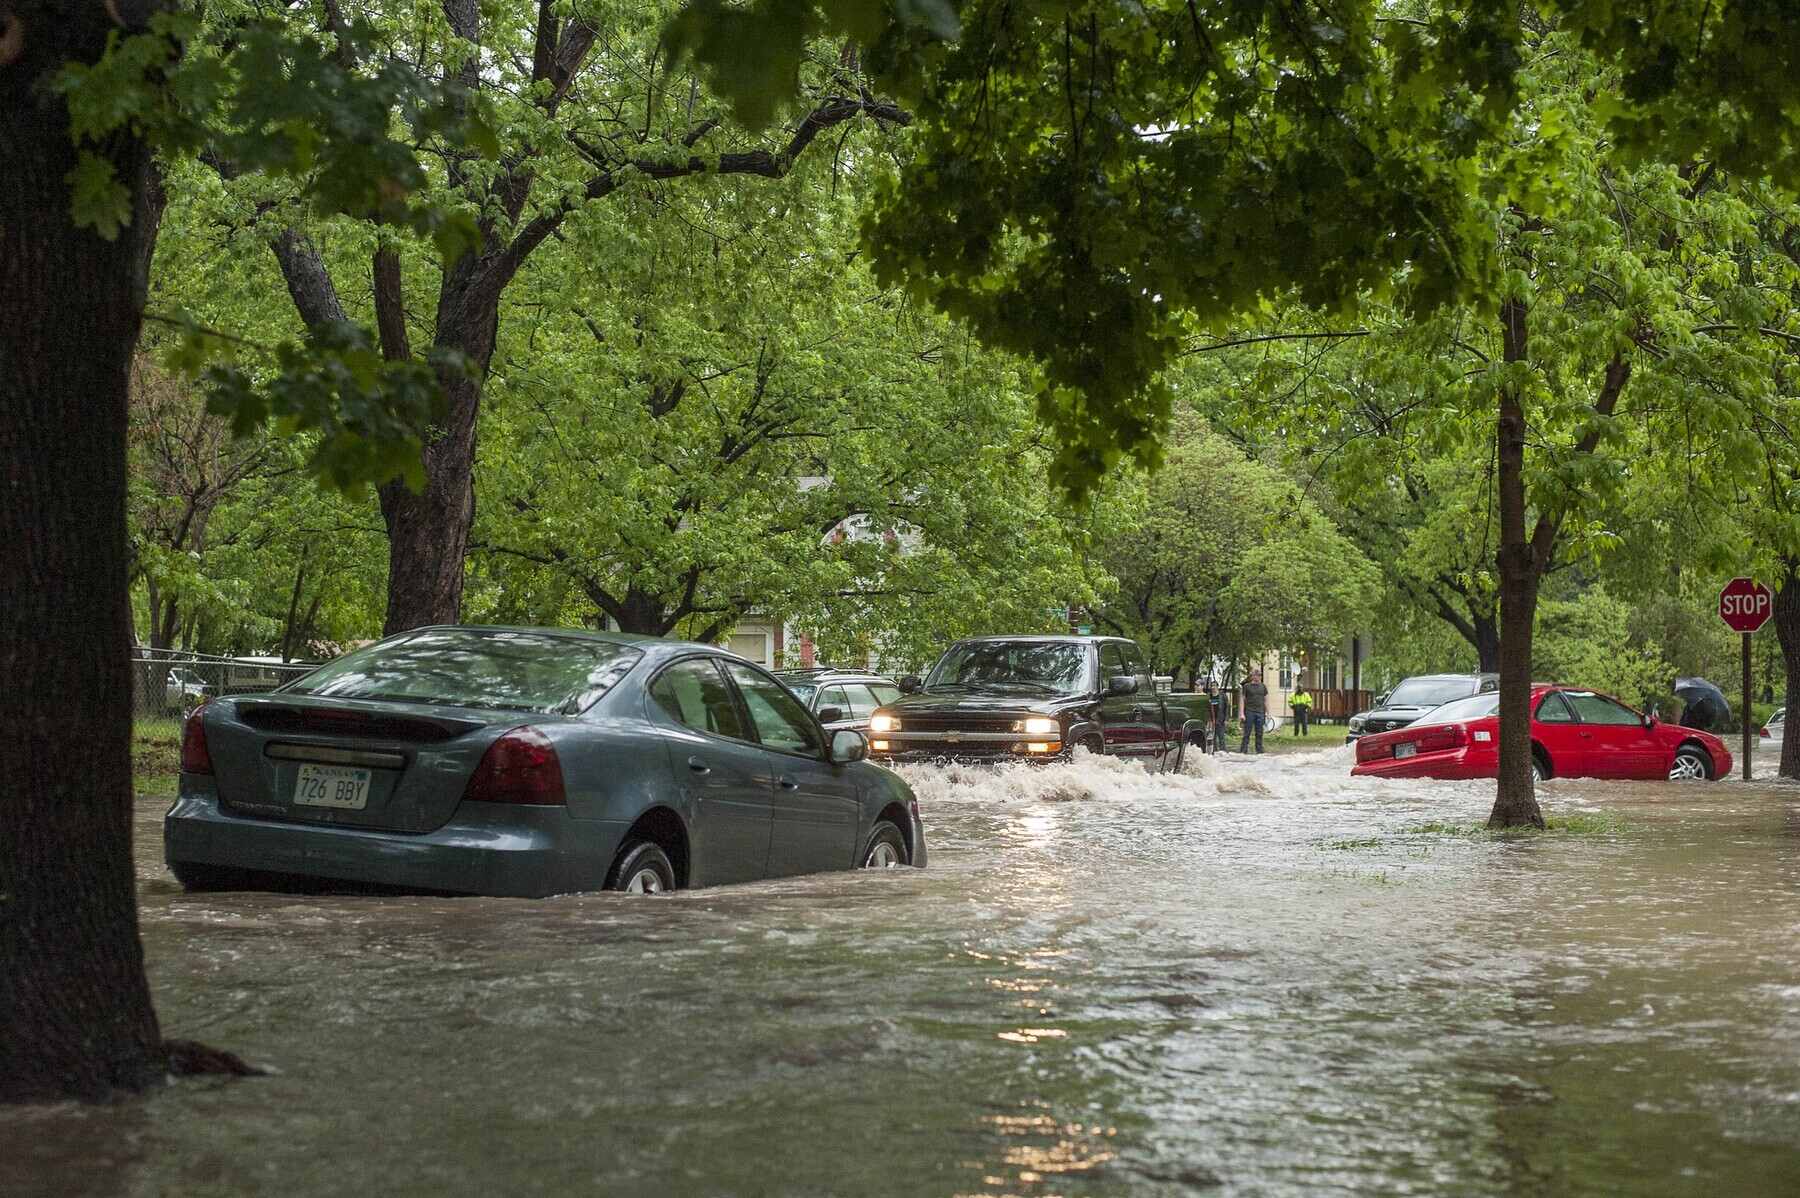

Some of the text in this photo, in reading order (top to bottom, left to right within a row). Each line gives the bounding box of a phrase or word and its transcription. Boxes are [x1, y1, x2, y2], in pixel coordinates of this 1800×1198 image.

[1722, 594, 1768, 615] STOP
[301, 777, 364, 801] 726 BBY
